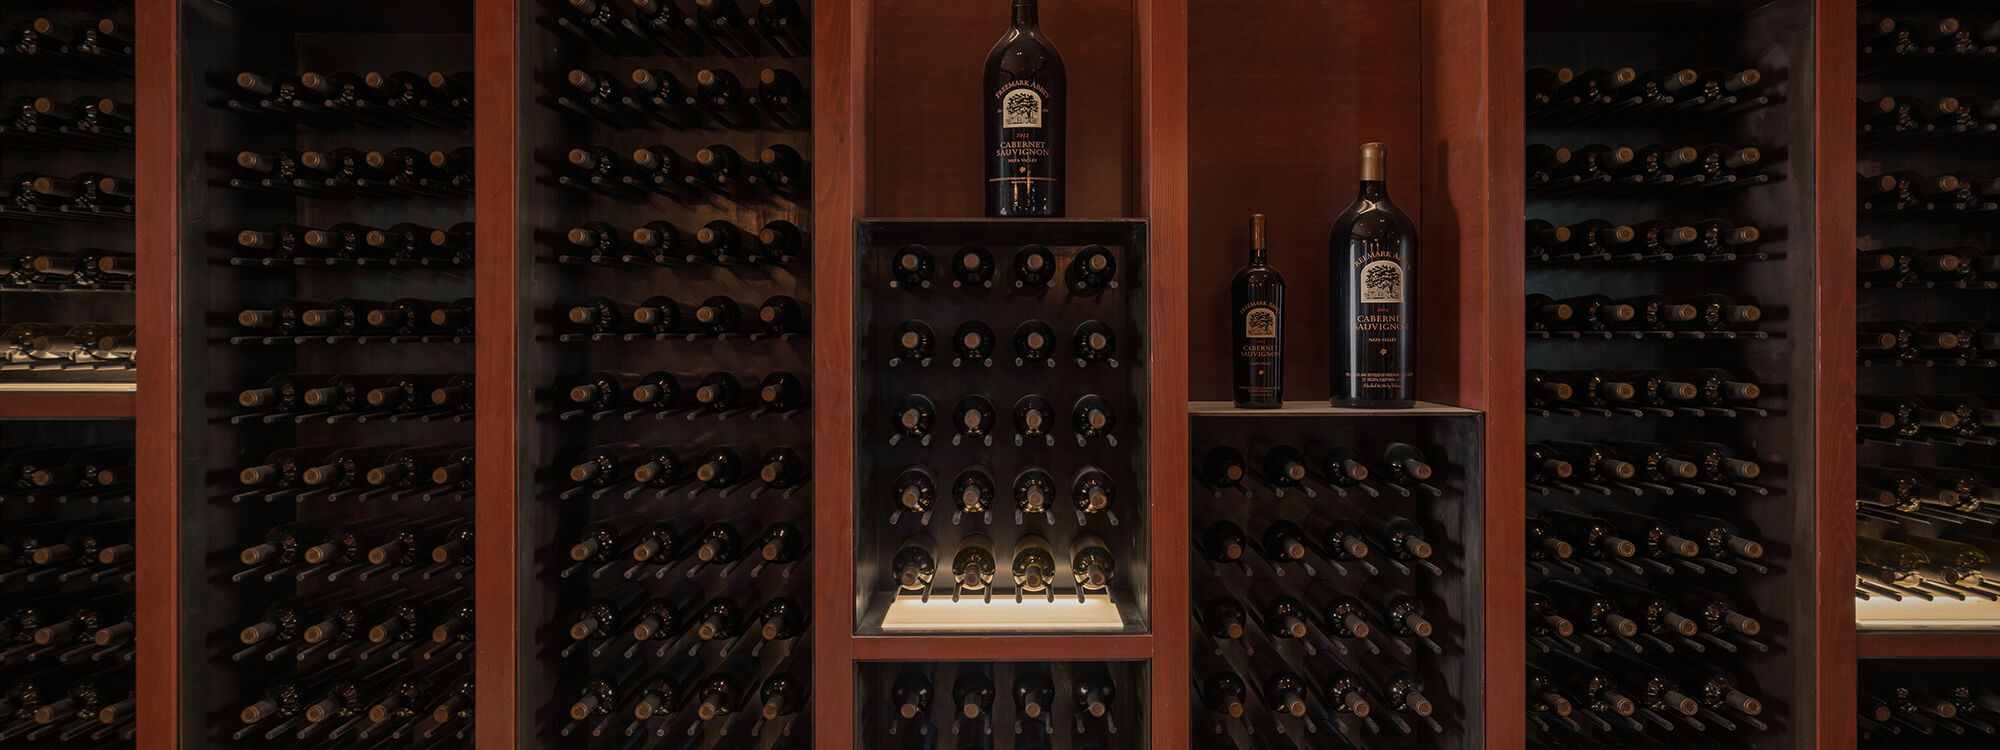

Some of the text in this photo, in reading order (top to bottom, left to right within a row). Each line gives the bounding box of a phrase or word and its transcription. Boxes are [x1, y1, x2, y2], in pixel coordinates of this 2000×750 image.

[995, 80, 1049, 99] FREEMARK ABBEY
[996, 148, 1049, 156] SAUVIGNON
[1352, 250, 1392, 270] REEMARK
